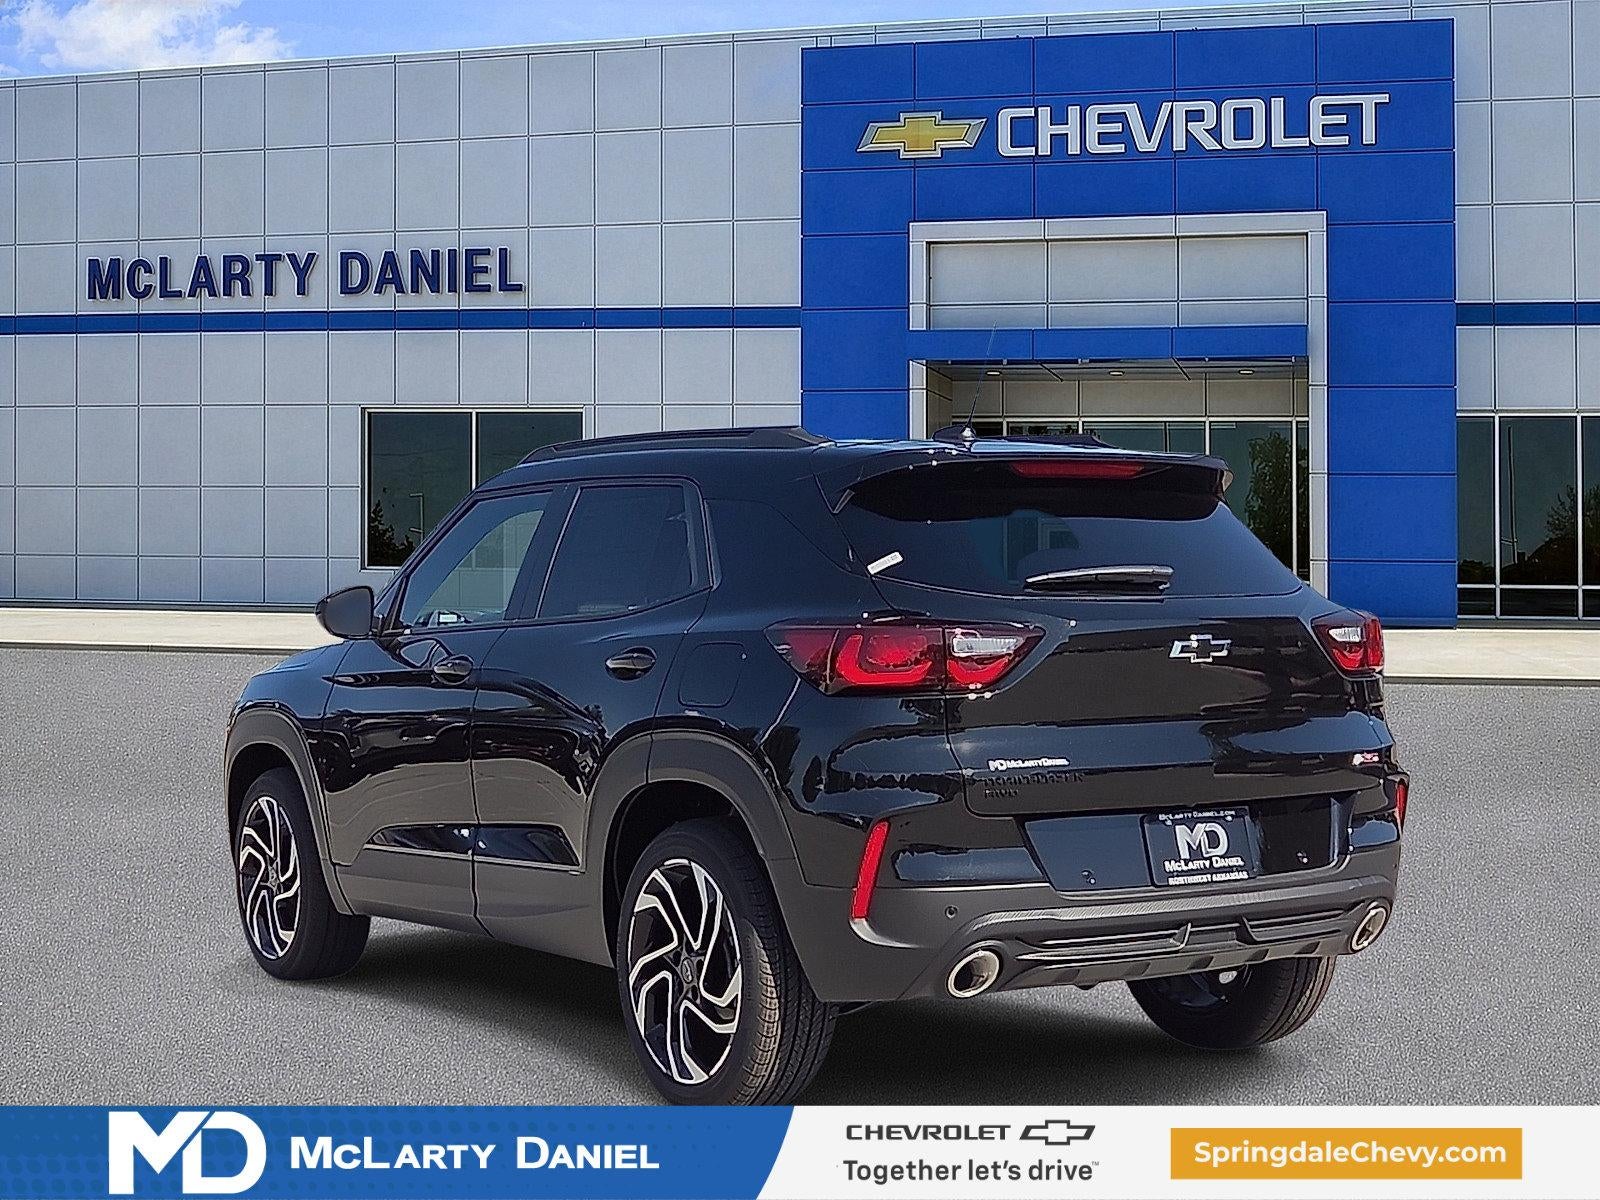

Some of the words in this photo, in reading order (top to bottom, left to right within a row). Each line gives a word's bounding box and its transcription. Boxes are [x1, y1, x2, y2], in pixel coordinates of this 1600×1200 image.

[997, 93, 1390, 157] CHEVROLET
[339, 247, 524, 296] DANIEL
[1175, 822, 1229, 860] MD
